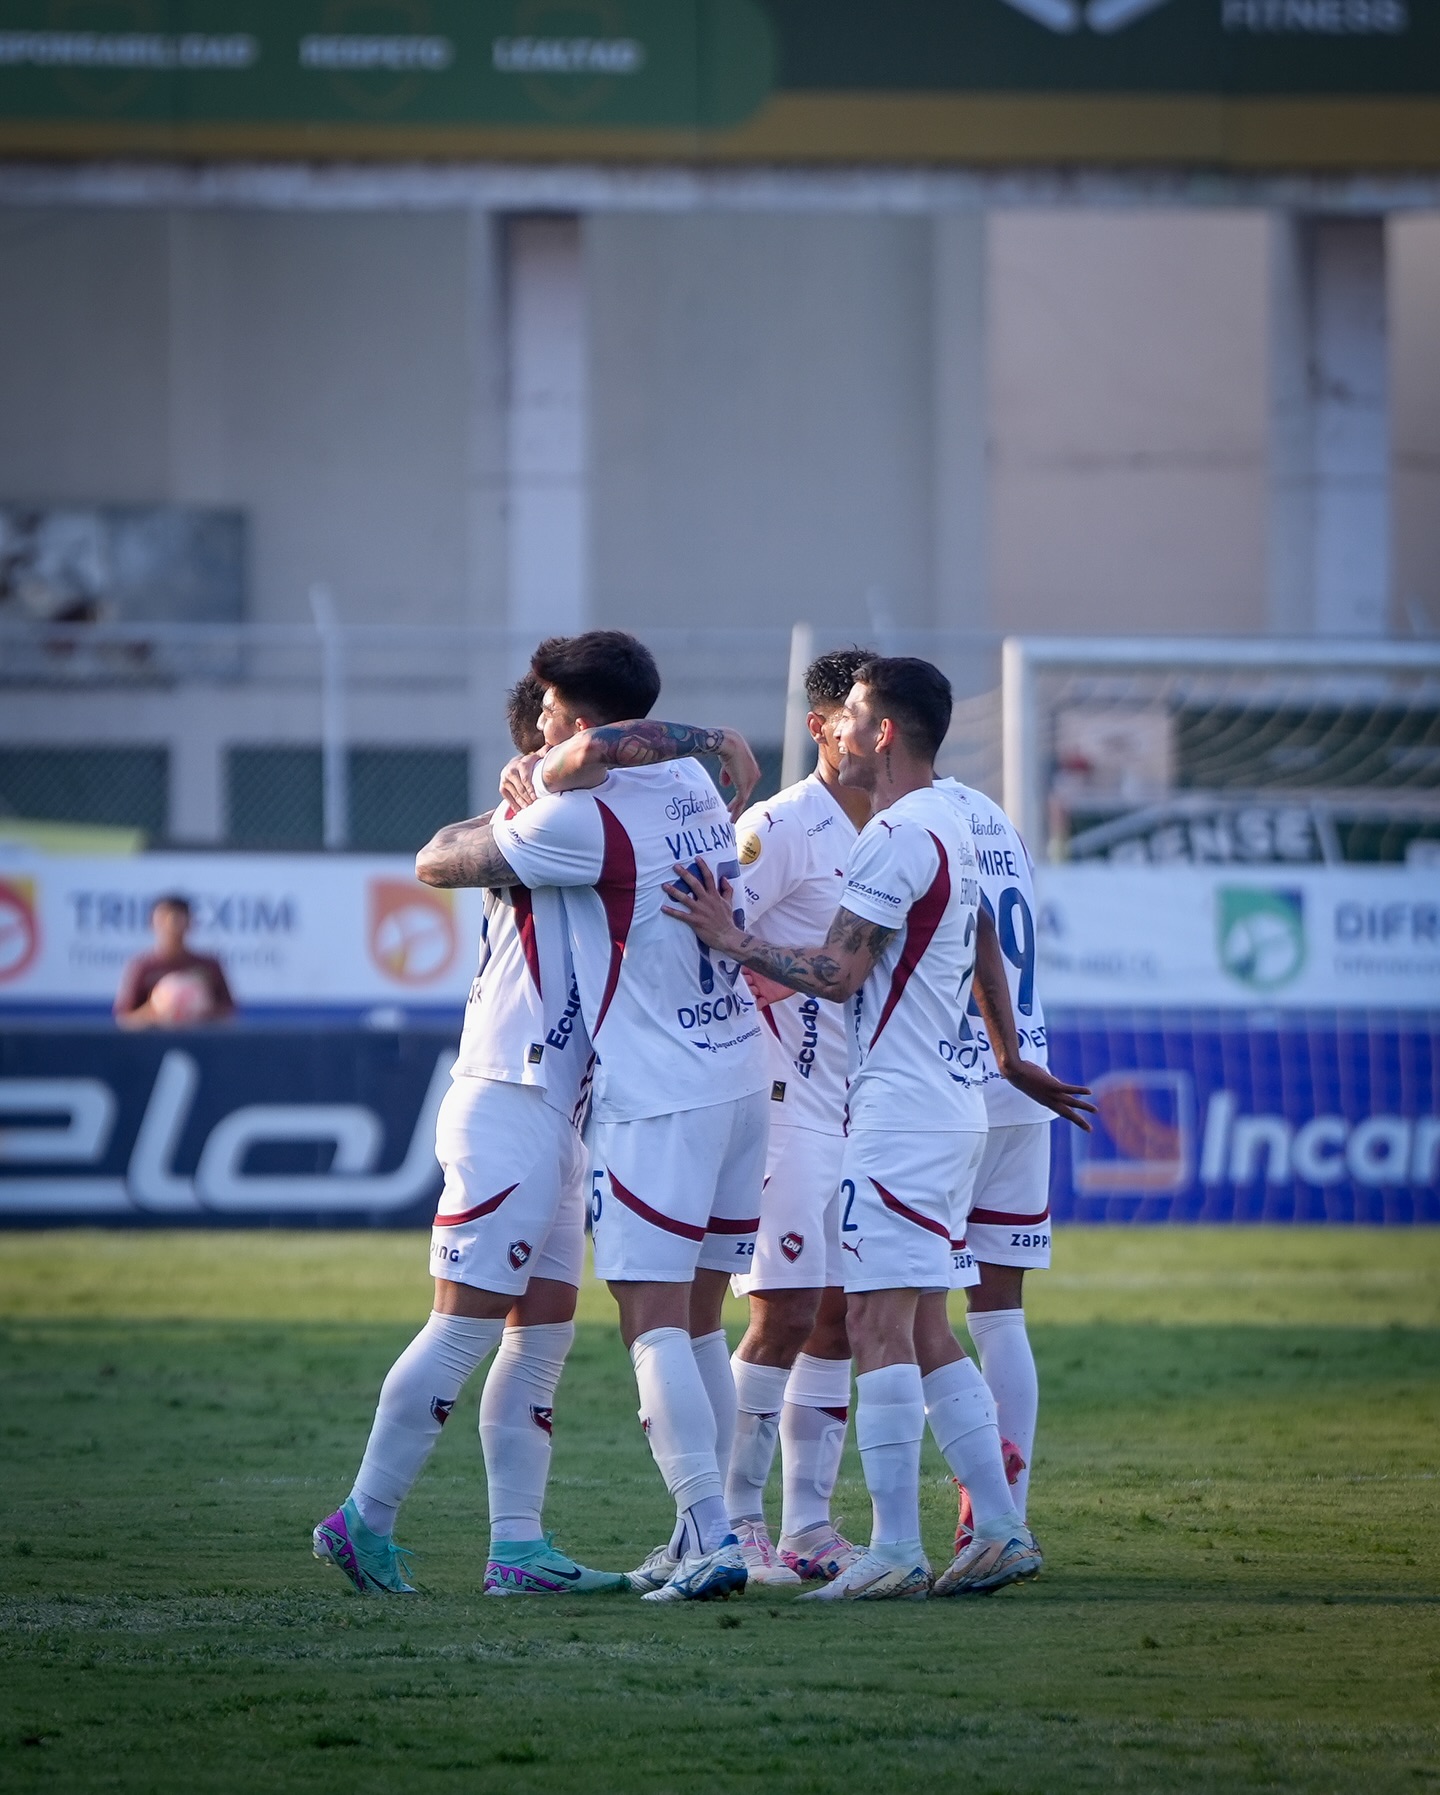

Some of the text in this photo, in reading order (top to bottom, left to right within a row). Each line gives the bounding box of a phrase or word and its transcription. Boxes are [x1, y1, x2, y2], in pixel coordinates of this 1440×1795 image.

[841, 1178, 858, 1232] 2
[782, 1237, 801, 1252] LDU
[512, 1245, 527, 1262] LDU
